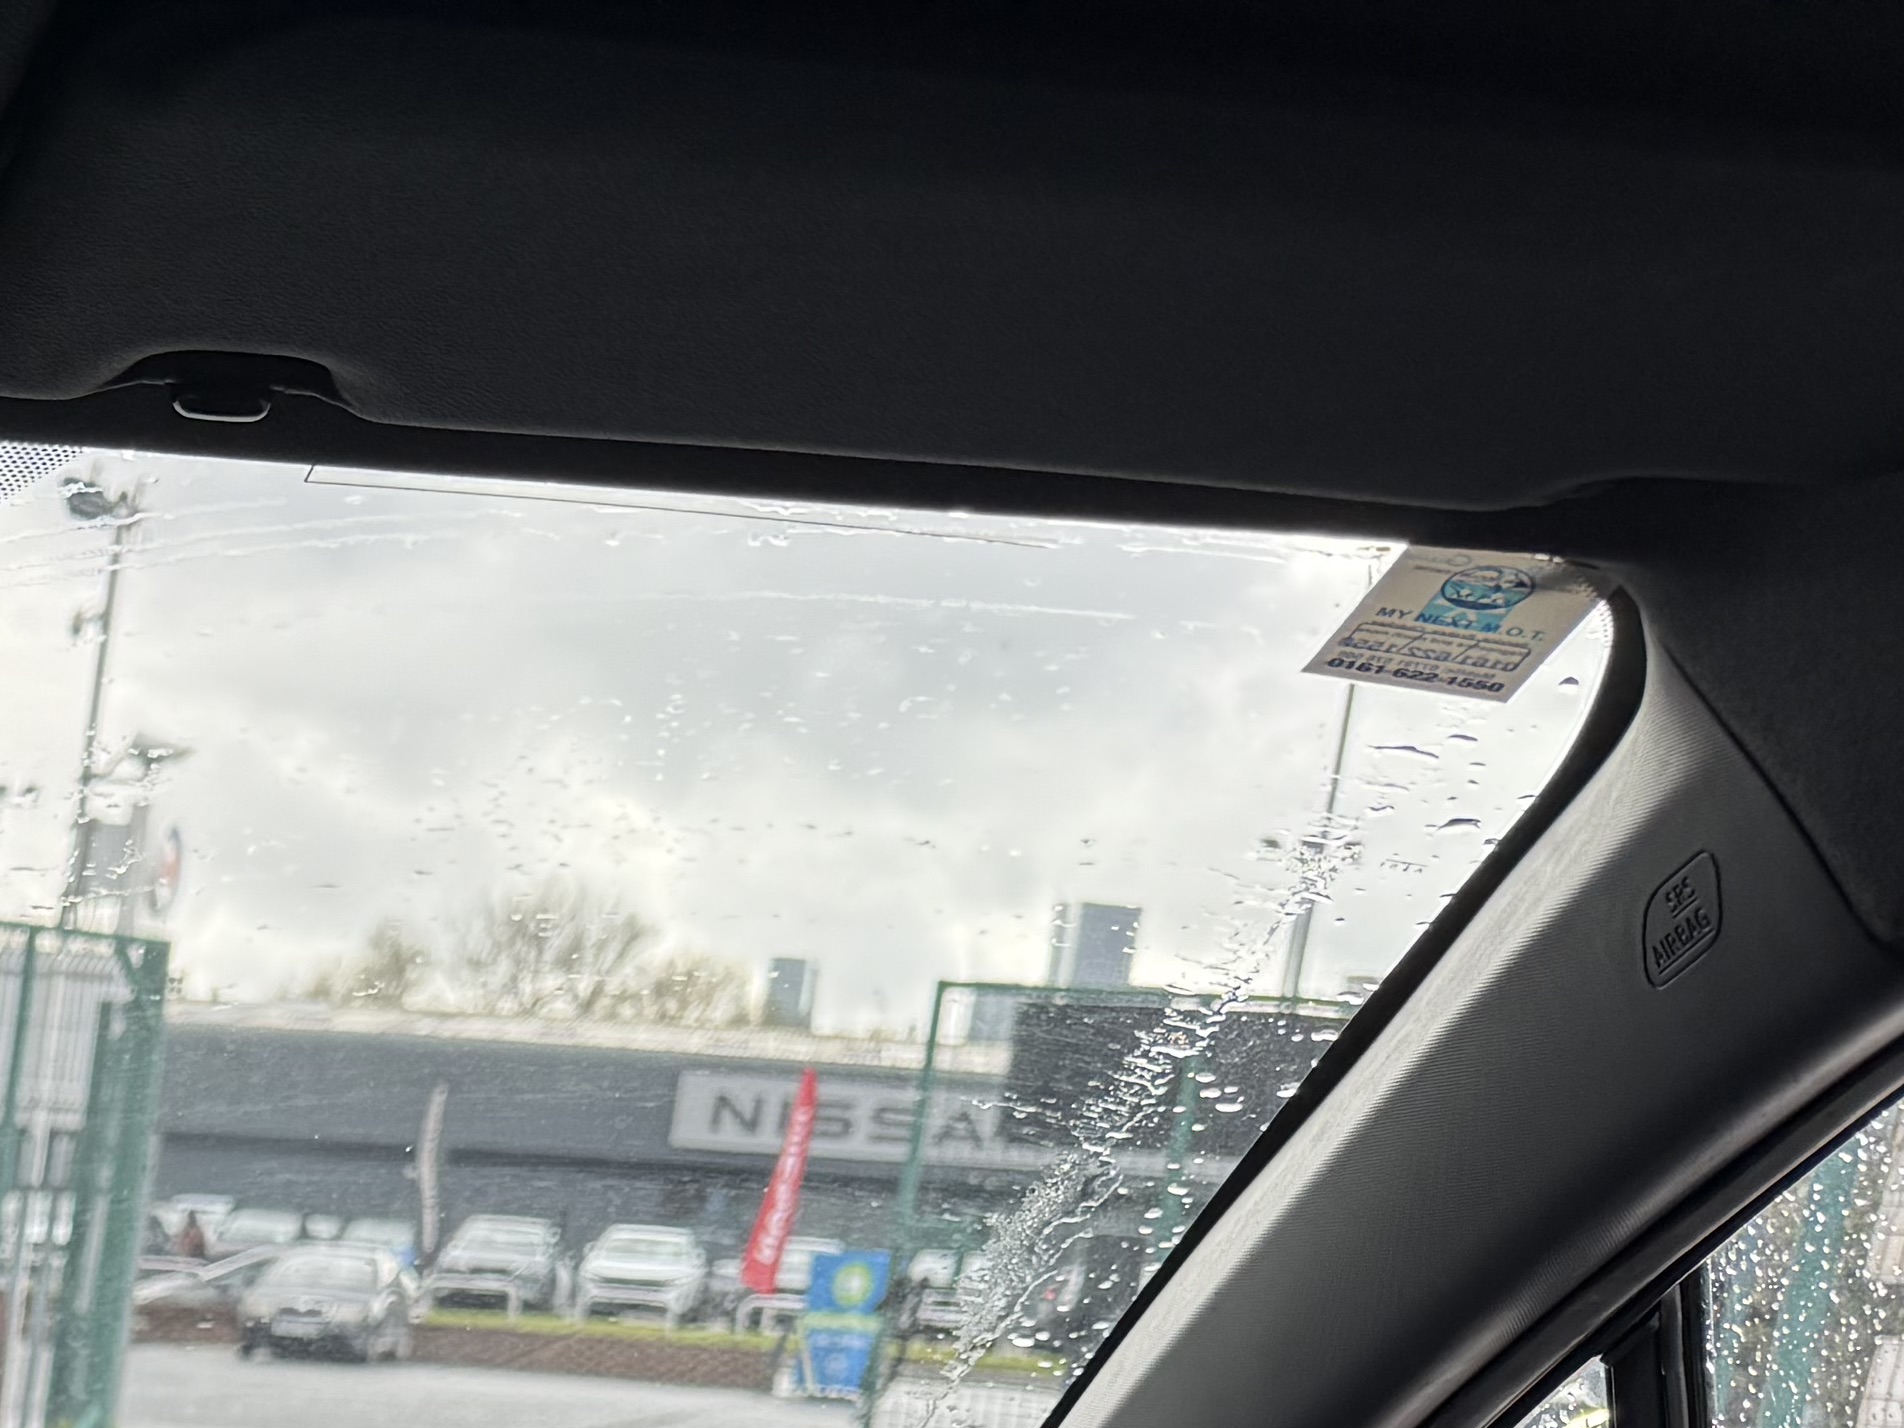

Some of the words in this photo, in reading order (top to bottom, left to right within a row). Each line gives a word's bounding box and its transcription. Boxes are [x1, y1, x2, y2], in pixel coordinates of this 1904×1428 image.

[1375, 607, 1414, 619] MY
[1413, 612, 1478, 630] NEXT
[1327, 657, 1385, 675] 0161
[1392, 668, 1439, 683] 622
[1651, 907, 1711, 968] AIRBAG
